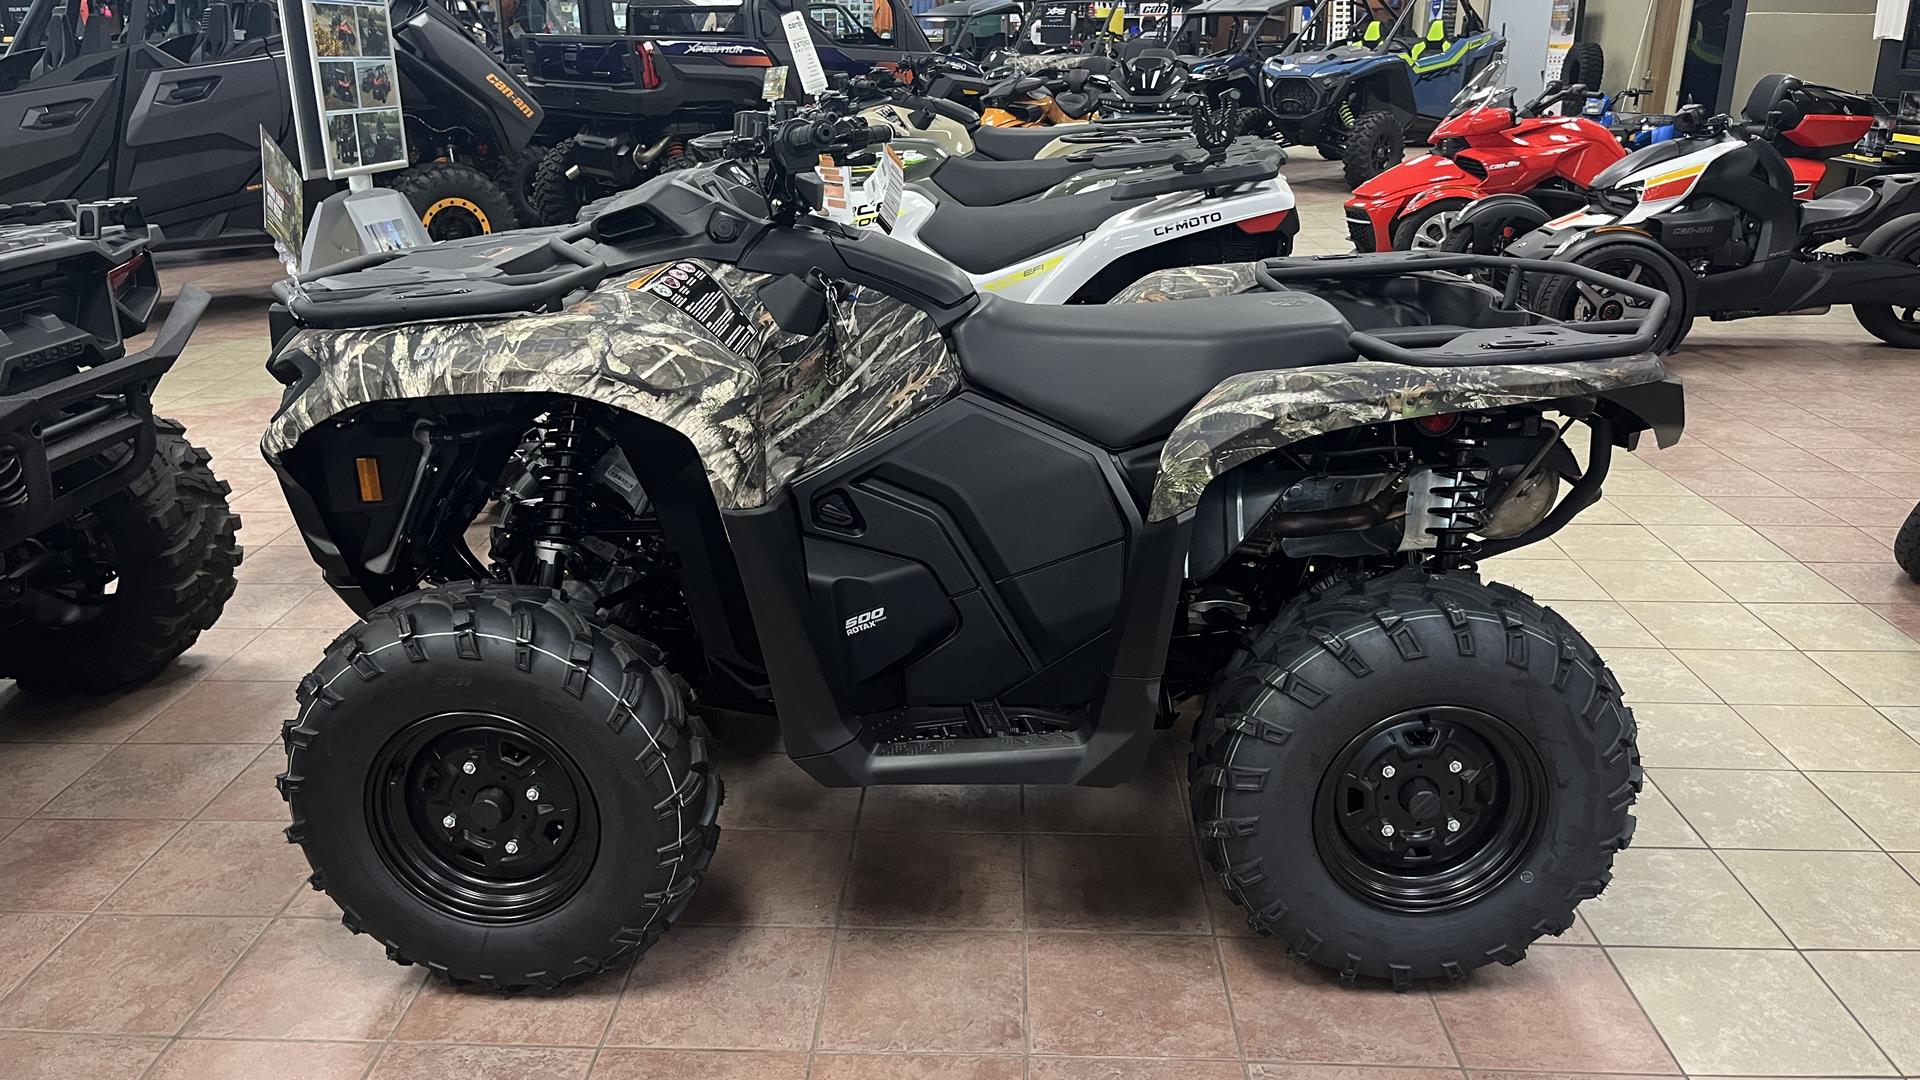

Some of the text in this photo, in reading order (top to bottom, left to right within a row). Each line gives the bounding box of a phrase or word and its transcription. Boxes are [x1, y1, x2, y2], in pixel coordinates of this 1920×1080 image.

[1045, 7, 1067, 15] XPS
[683, 41, 744, 54] XPEDITION
[1415, 63, 1463, 86] RZR
[485, 73, 535, 118] can-am
[1489, 160, 1521, 170] can-am
[1153, 211, 1222, 237] CFMOTO
[1672, 225, 1714, 235] can-am
[1023, 263, 1045, 277] EFI
[22, 341, 83, 368] POLARIS
[845, 607, 884, 630] 500
[846, 620, 876, 637] ROTAX
